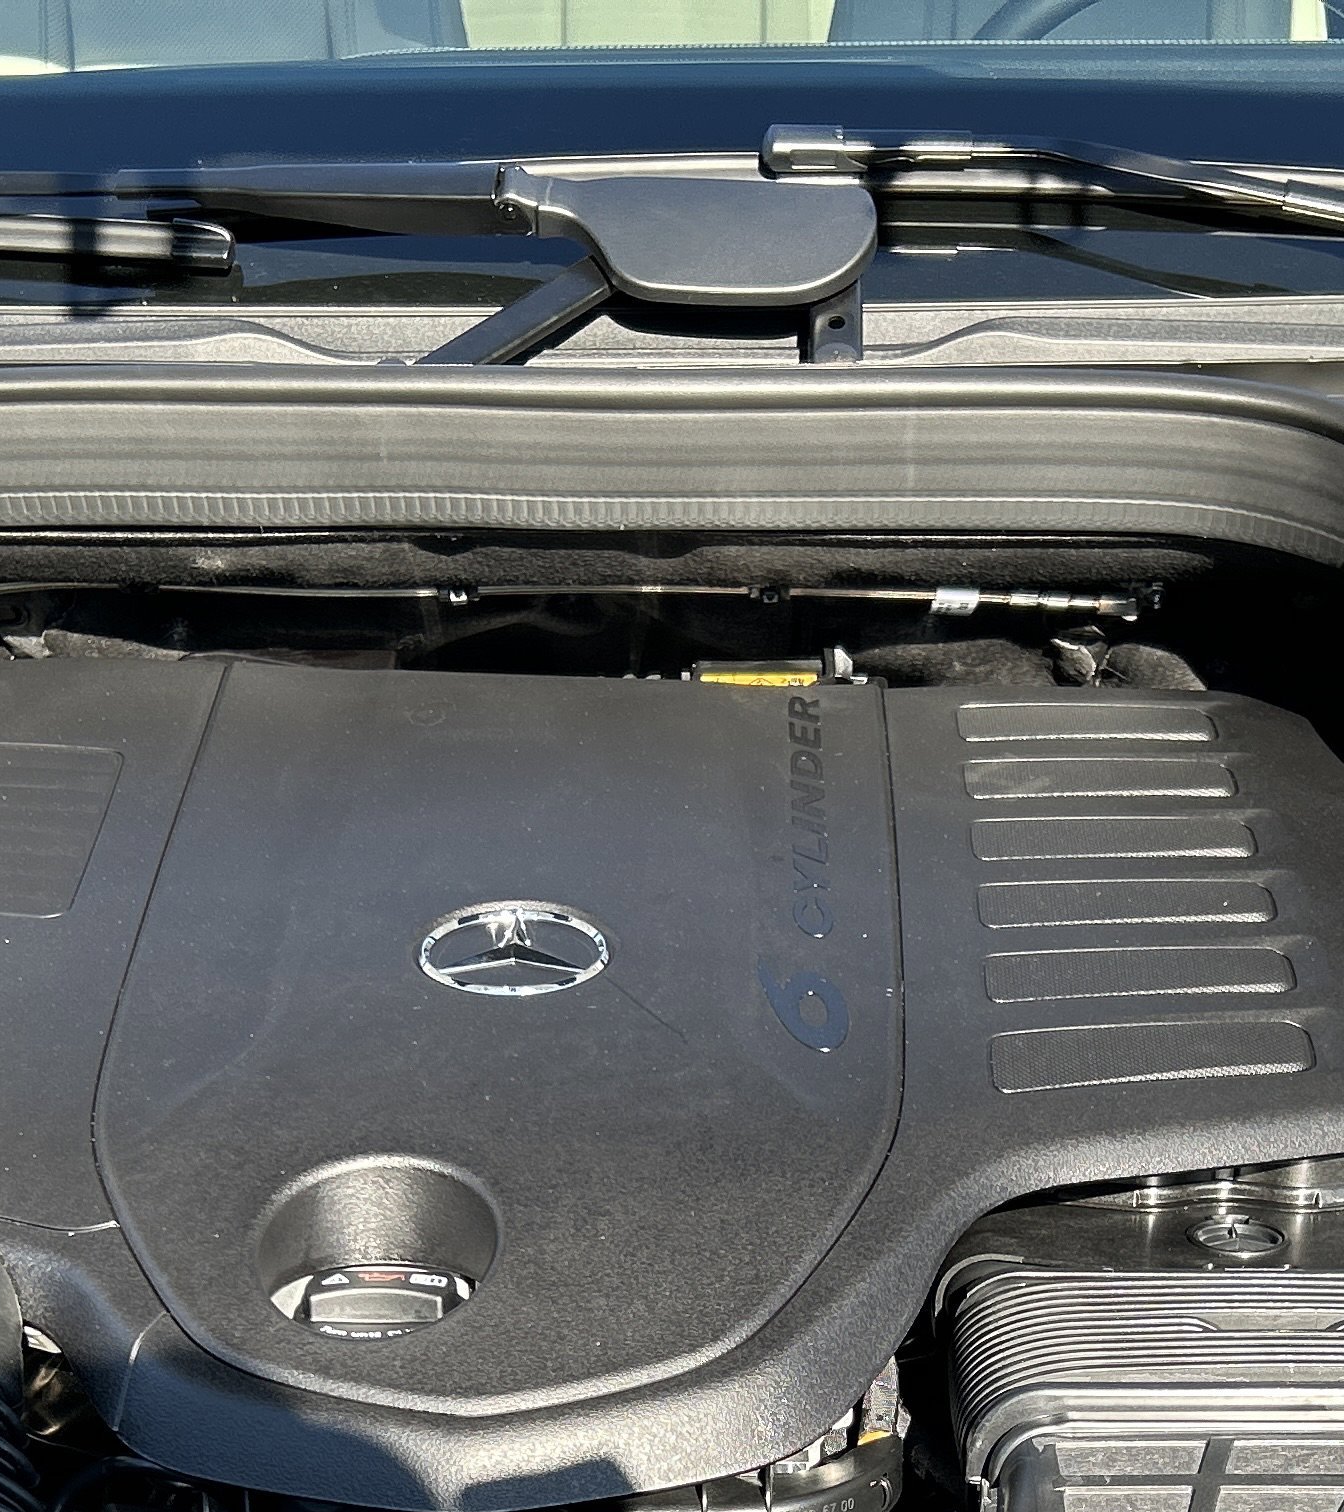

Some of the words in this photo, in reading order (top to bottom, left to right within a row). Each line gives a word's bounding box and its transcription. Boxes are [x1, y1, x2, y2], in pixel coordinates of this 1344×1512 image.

[787, 694, 835, 939] CYLINDER
[758, 957, 851, 1053] 6
[840, 1498, 855, 1512] 00
